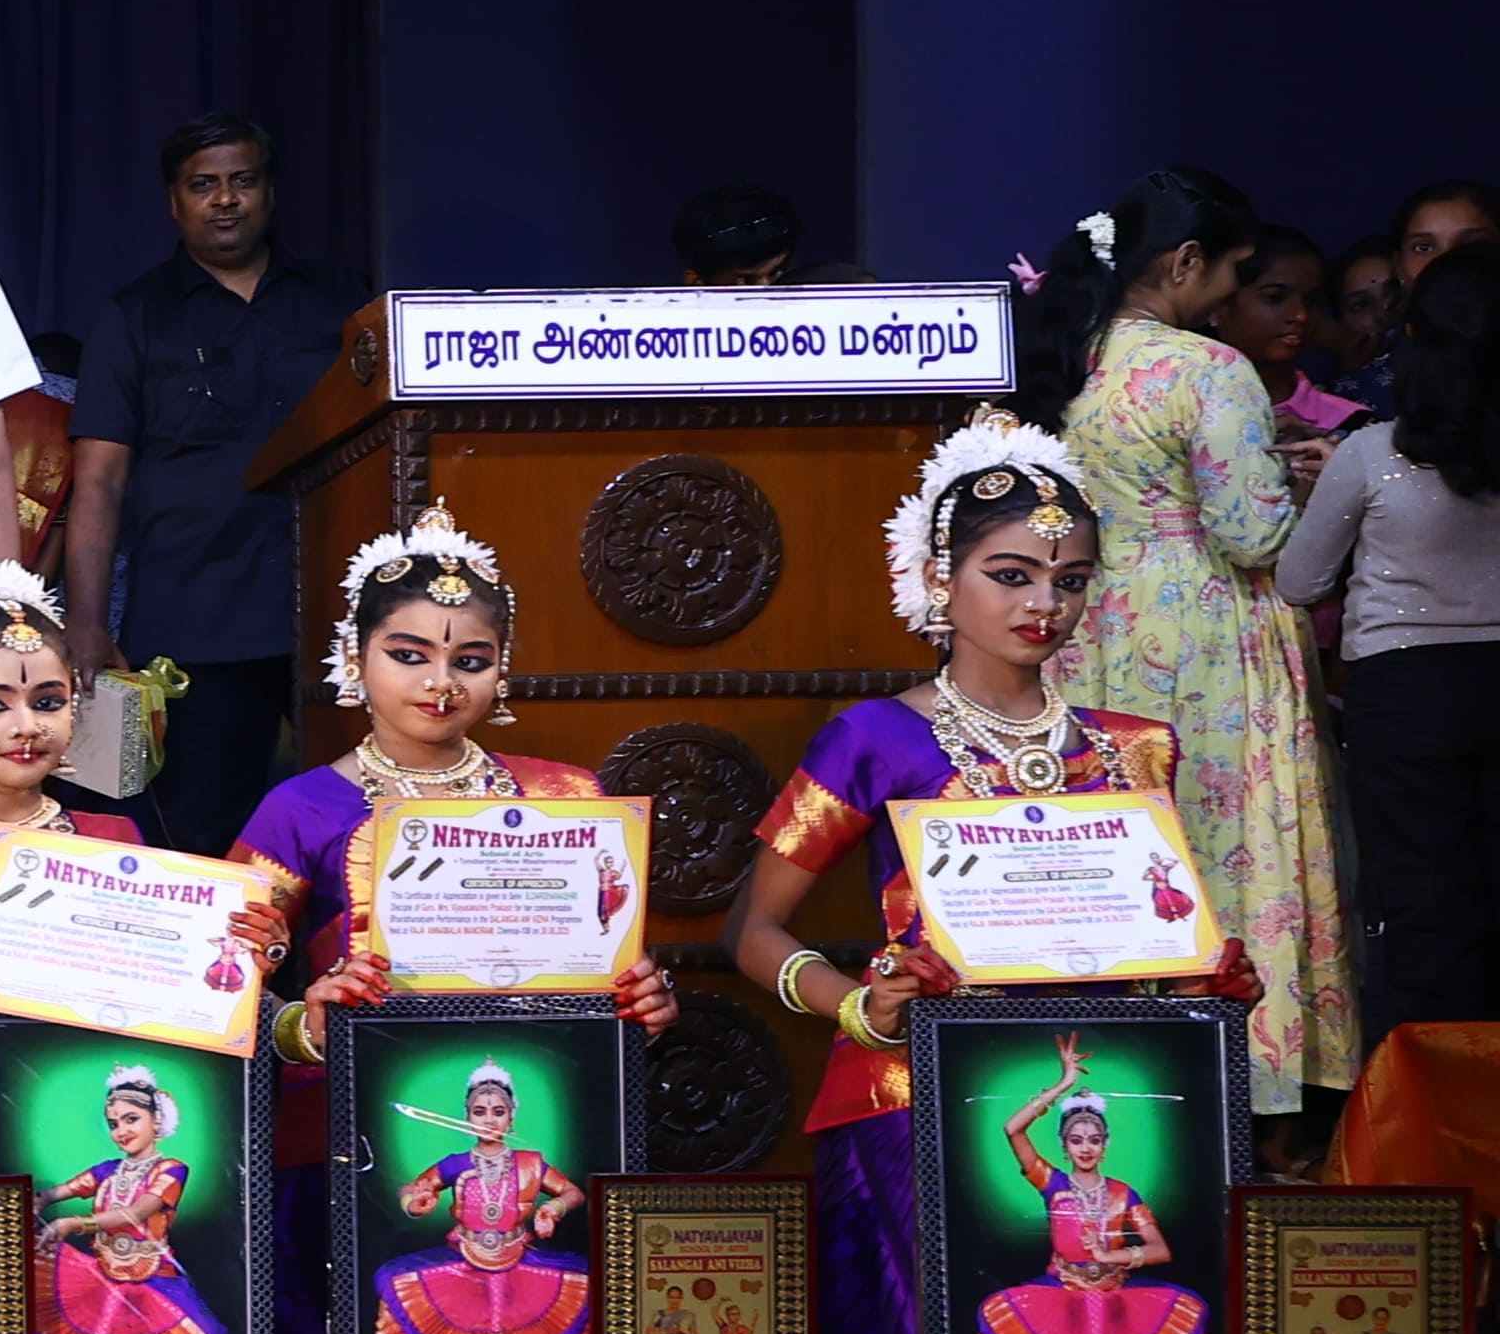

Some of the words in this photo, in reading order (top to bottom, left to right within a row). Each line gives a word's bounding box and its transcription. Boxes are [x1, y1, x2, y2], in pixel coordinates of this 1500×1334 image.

[425, 331, 520, 369] ராஜா
[532, 313, 826, 364] அண்ணாமலை
[839, 307, 978, 369] மன்றம்
[433, 824, 596, 848] NATYAVIJAYAM
[956, 818, 1129, 845] NATYAVIJAYAM
[44, 857, 215, 907] NATYAVIJAYAM
